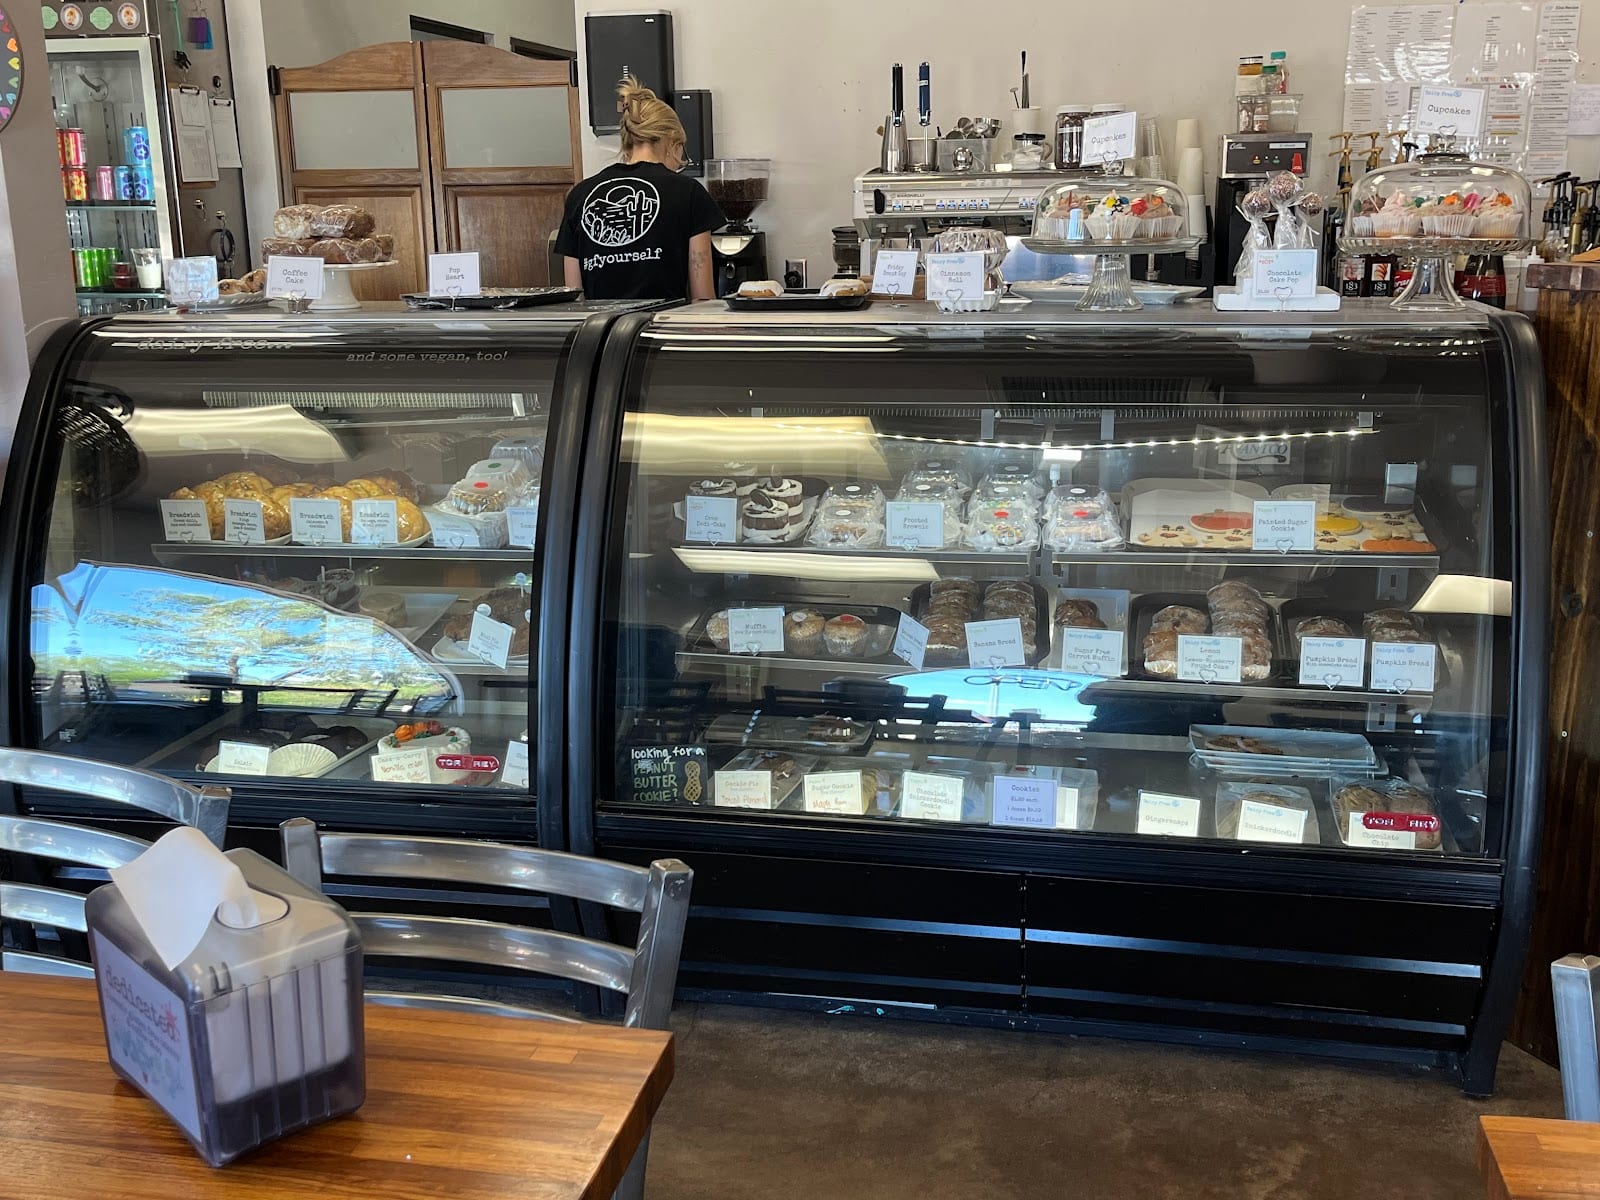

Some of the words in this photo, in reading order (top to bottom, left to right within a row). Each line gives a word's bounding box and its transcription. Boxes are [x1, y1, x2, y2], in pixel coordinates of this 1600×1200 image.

[1427, 104, 1471, 115] Cupcakes
[1091, 132, 1126, 145] Cupcakes
[583, 247, 663, 271] #gfyourself
[282, 268, 308, 277] Coffee
[285, 276, 304, 284] Cake
[1286, 276, 1299, 284] Pop
[347, 351, 376, 362] and
[379, 353, 417, 362] some
[420, 353, 471, 364] vegan,
[476, 350, 509, 362] too!
[299, 512, 335, 520] Breadwich
[1258, 518, 1286, 526] Painted
[1286, 518, 1309, 527] Sugar
[973, 639, 998, 649] Banana
[998, 638, 1017, 646] Bread
[1074, 646, 1095, 655] Sugar
[1068, 652, 1092, 661] Carrot
[1305, 656, 1335, 664] Pumpkin
[1376, 658, 1407, 666] Pumpkin
[1408, 659, 1430, 667] Bread
[631, 747, 673, 765] looking
[673, 747, 693, 757] for
[695, 747, 706, 756] a
[438, 758, 461, 767] TOR
[473, 760, 496, 769] REY
[633, 760, 677, 776] PEANUT
[633, 776, 678, 789] BUTTER
[1011, 784, 1040, 793] Cookies
[633, 788, 679, 802] COOKIE?
[1145, 814, 1189, 826] Gingersnaps
[1362, 831, 1399, 841] Chocolate
